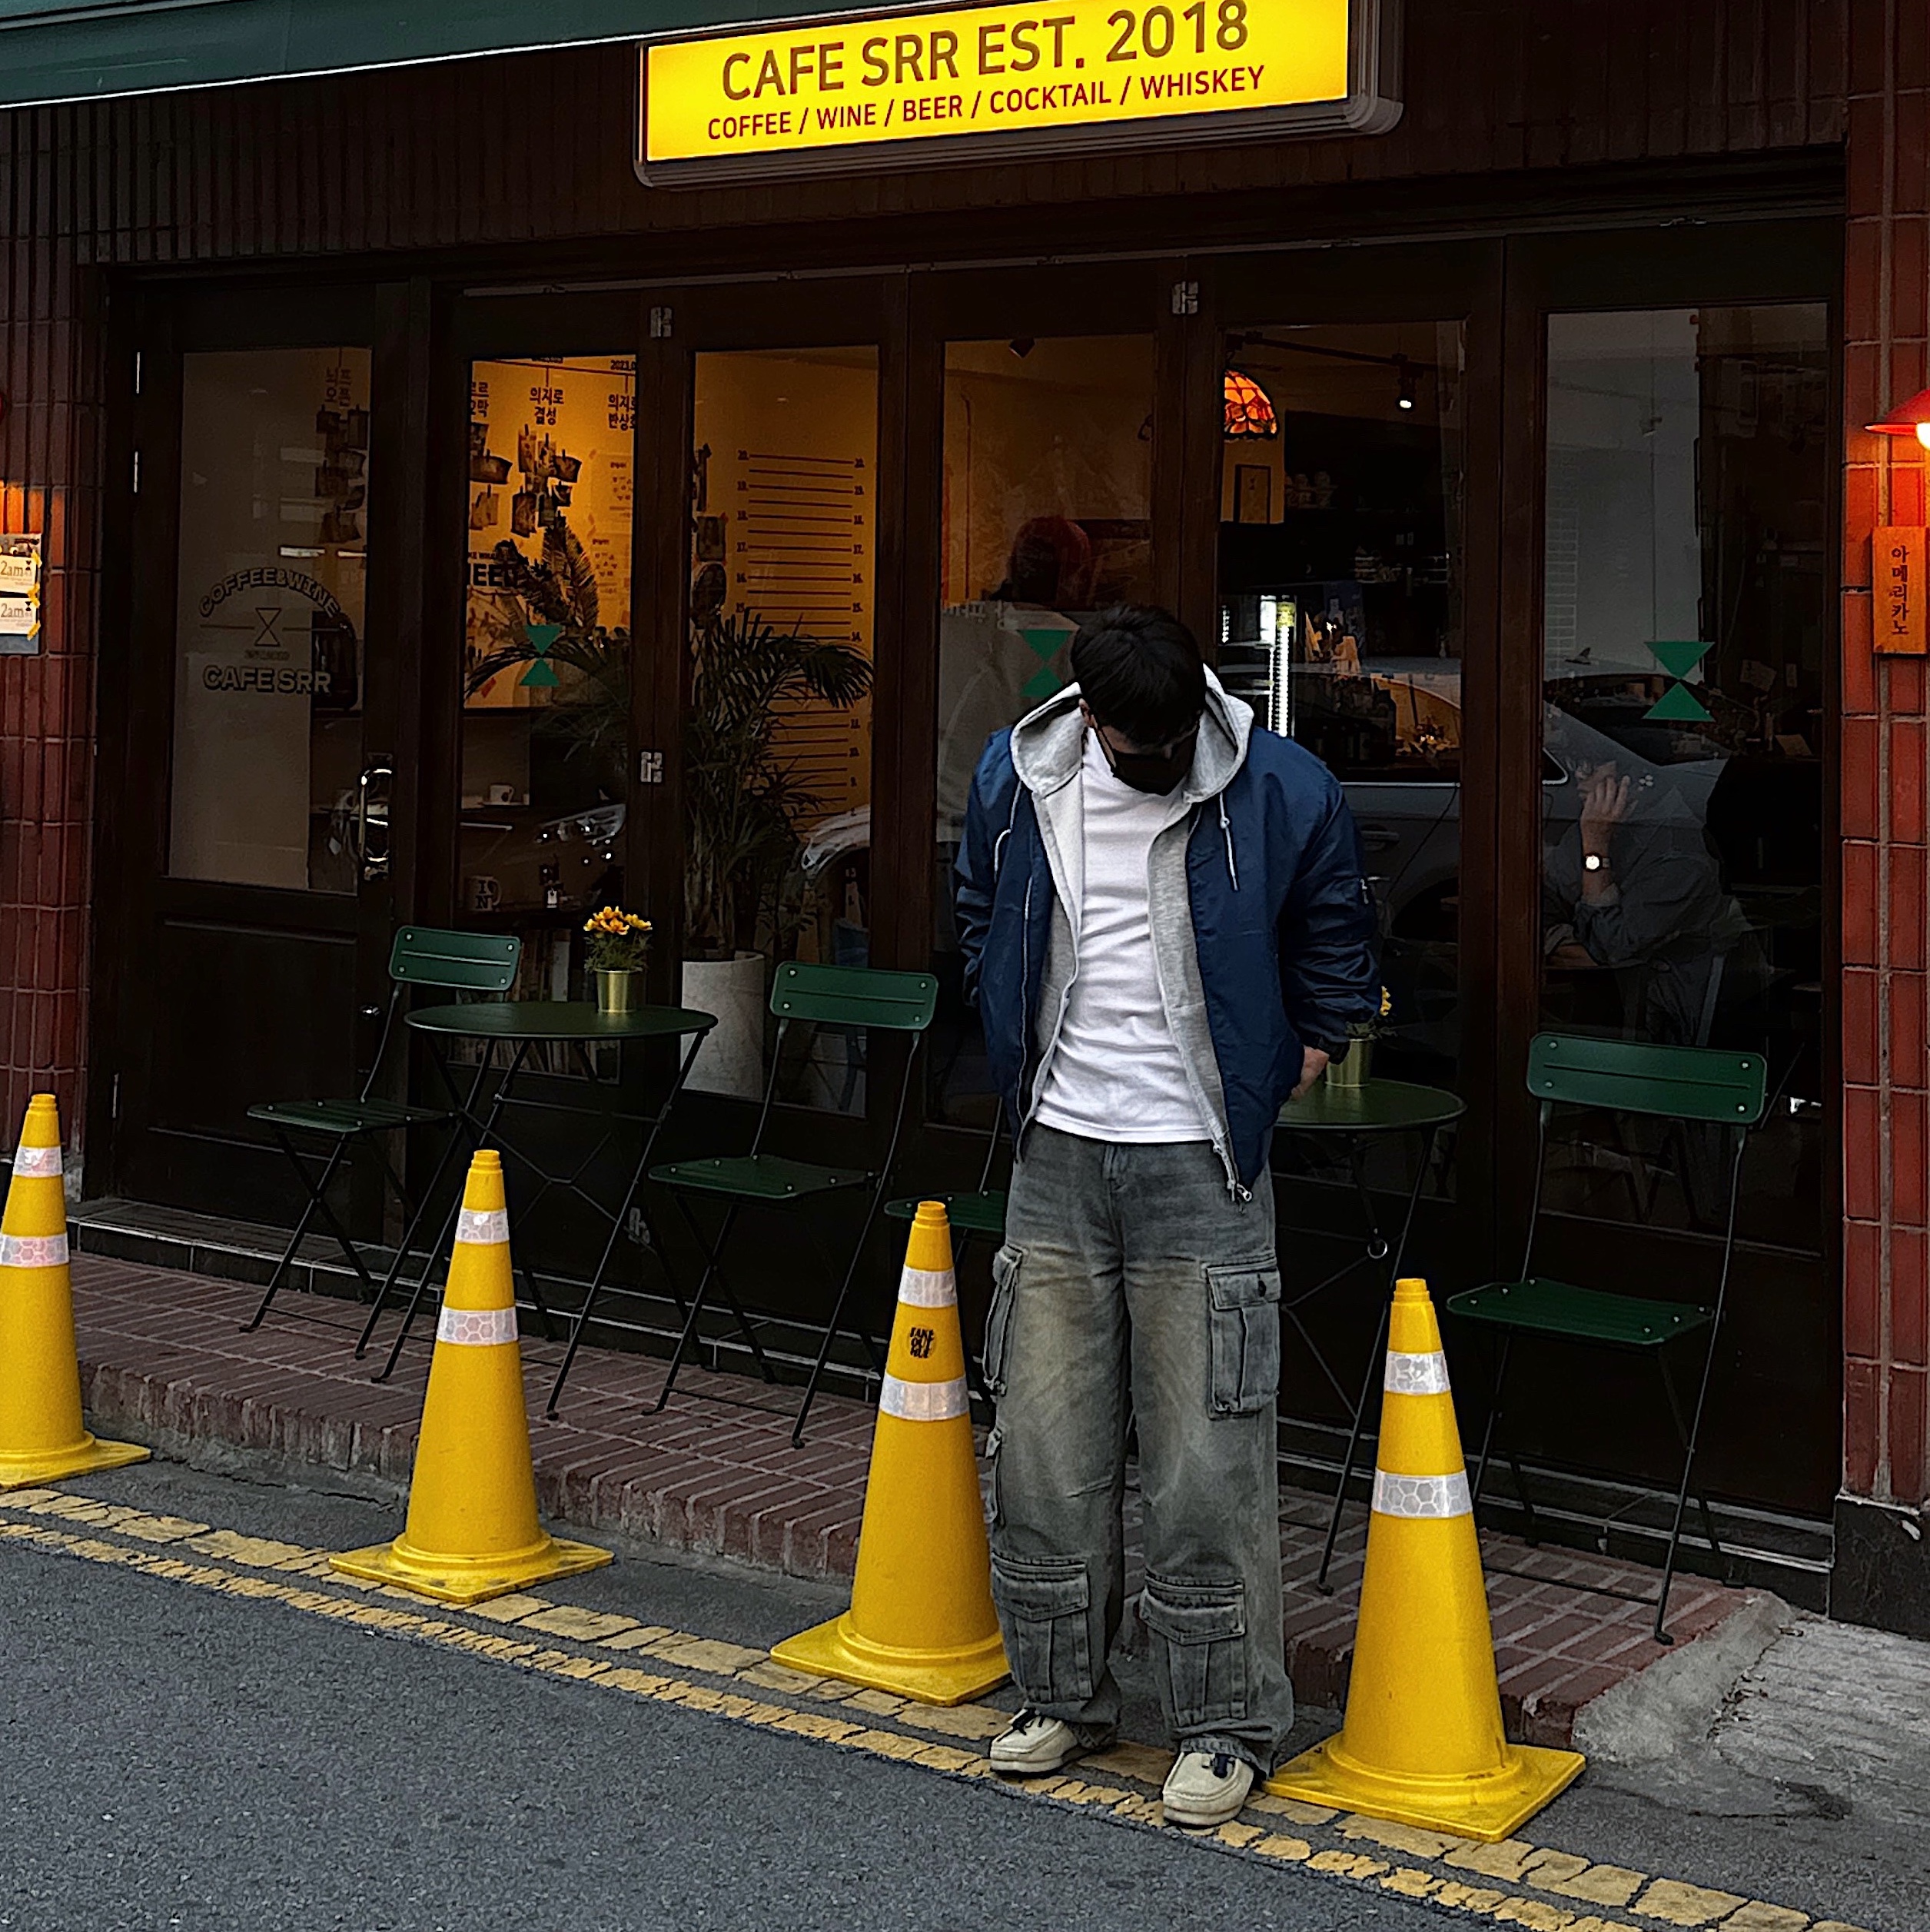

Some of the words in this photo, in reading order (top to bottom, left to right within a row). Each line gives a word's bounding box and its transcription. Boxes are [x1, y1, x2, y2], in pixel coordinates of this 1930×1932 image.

[723, 41, 845, 101] CAFE
[861, 30, 959, 87] SRR
[978, 15, 1085, 76] EST.
[1105, 0, 1248, 62] 2018
[708, 111, 792, 140] COFFEE
[816, 103, 877, 130] WINE
[902, 95, 963, 122] BEER
[989, 80, 1112, 115] COCKTAIL
[1139, 65, 1265, 100] WHISKEY
[530, 387, 564, 405] 의지로
[199, 567, 341, 619] COFFEE&WINE
[1891, 544, 1910, 636] 아메리카노
[201, 664, 275, 693] CAFE
[276, 667, 332, 694] SRR
